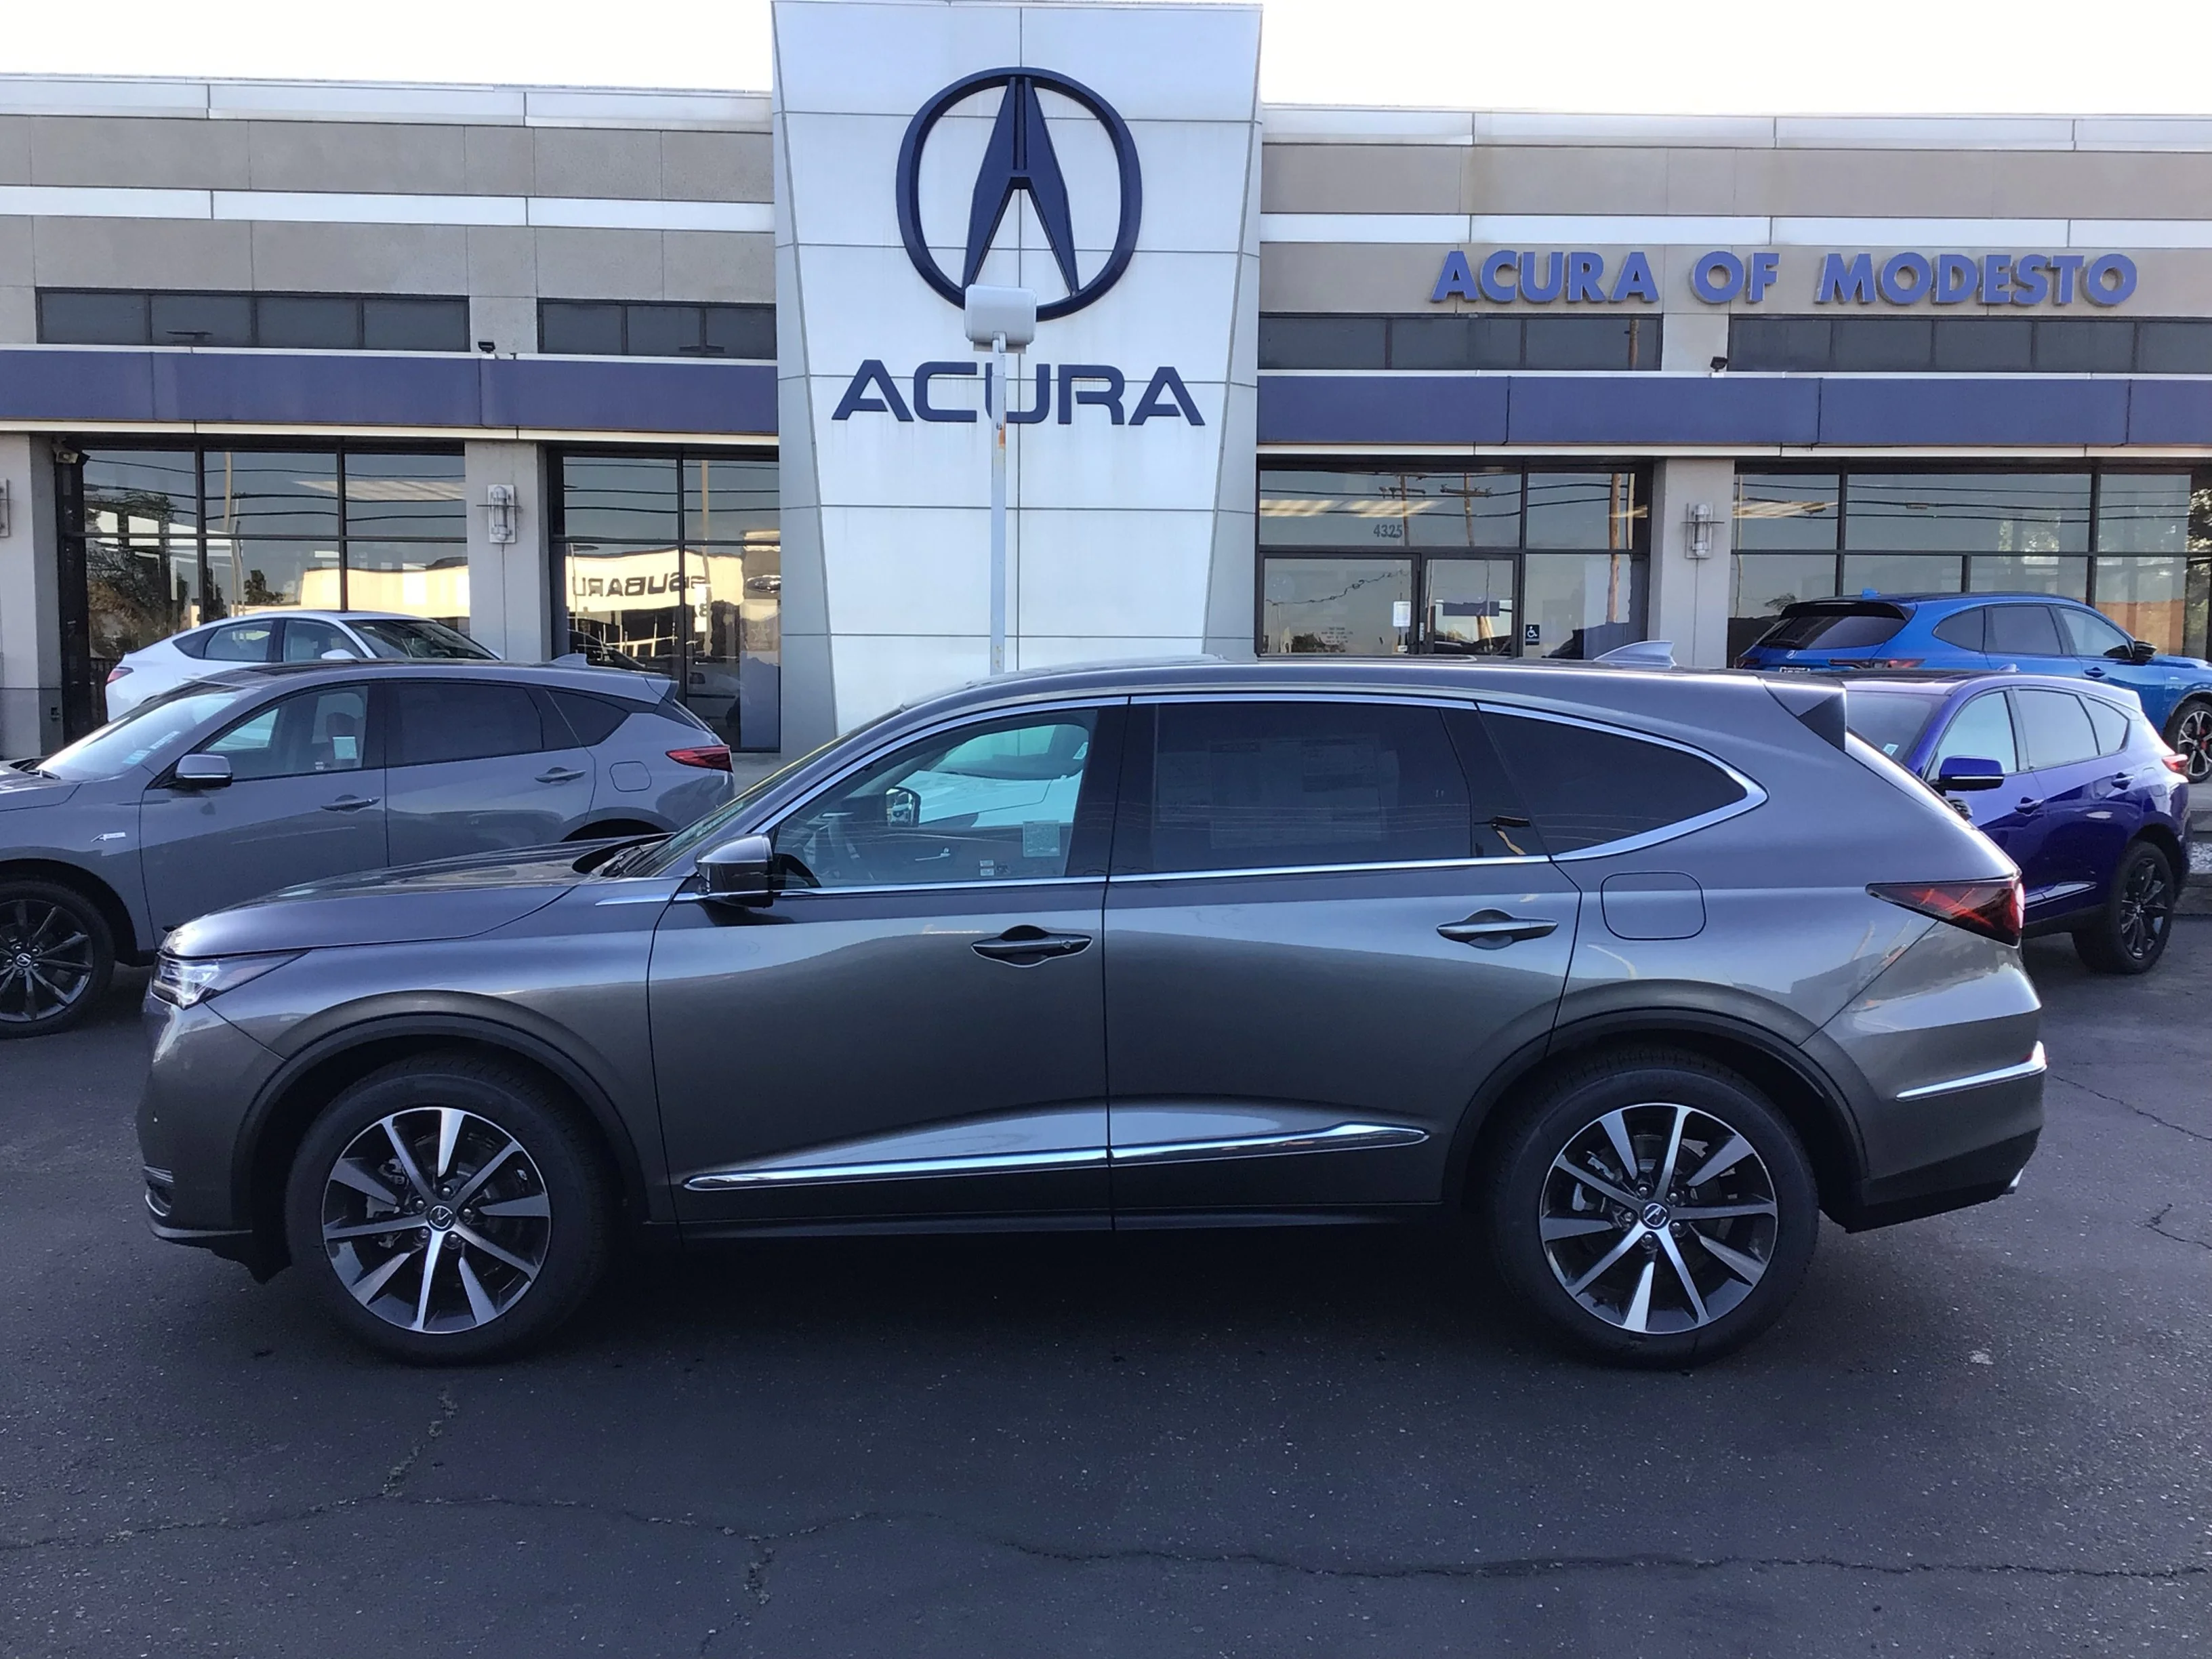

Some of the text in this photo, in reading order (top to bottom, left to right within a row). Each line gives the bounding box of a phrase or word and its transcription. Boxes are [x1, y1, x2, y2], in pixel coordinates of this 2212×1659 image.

[1430, 249, 2138, 307] ACURA OF MODESTO
[831, 359, 1206, 426] ACURA
[1373, 524, 1403, 538] 4325
